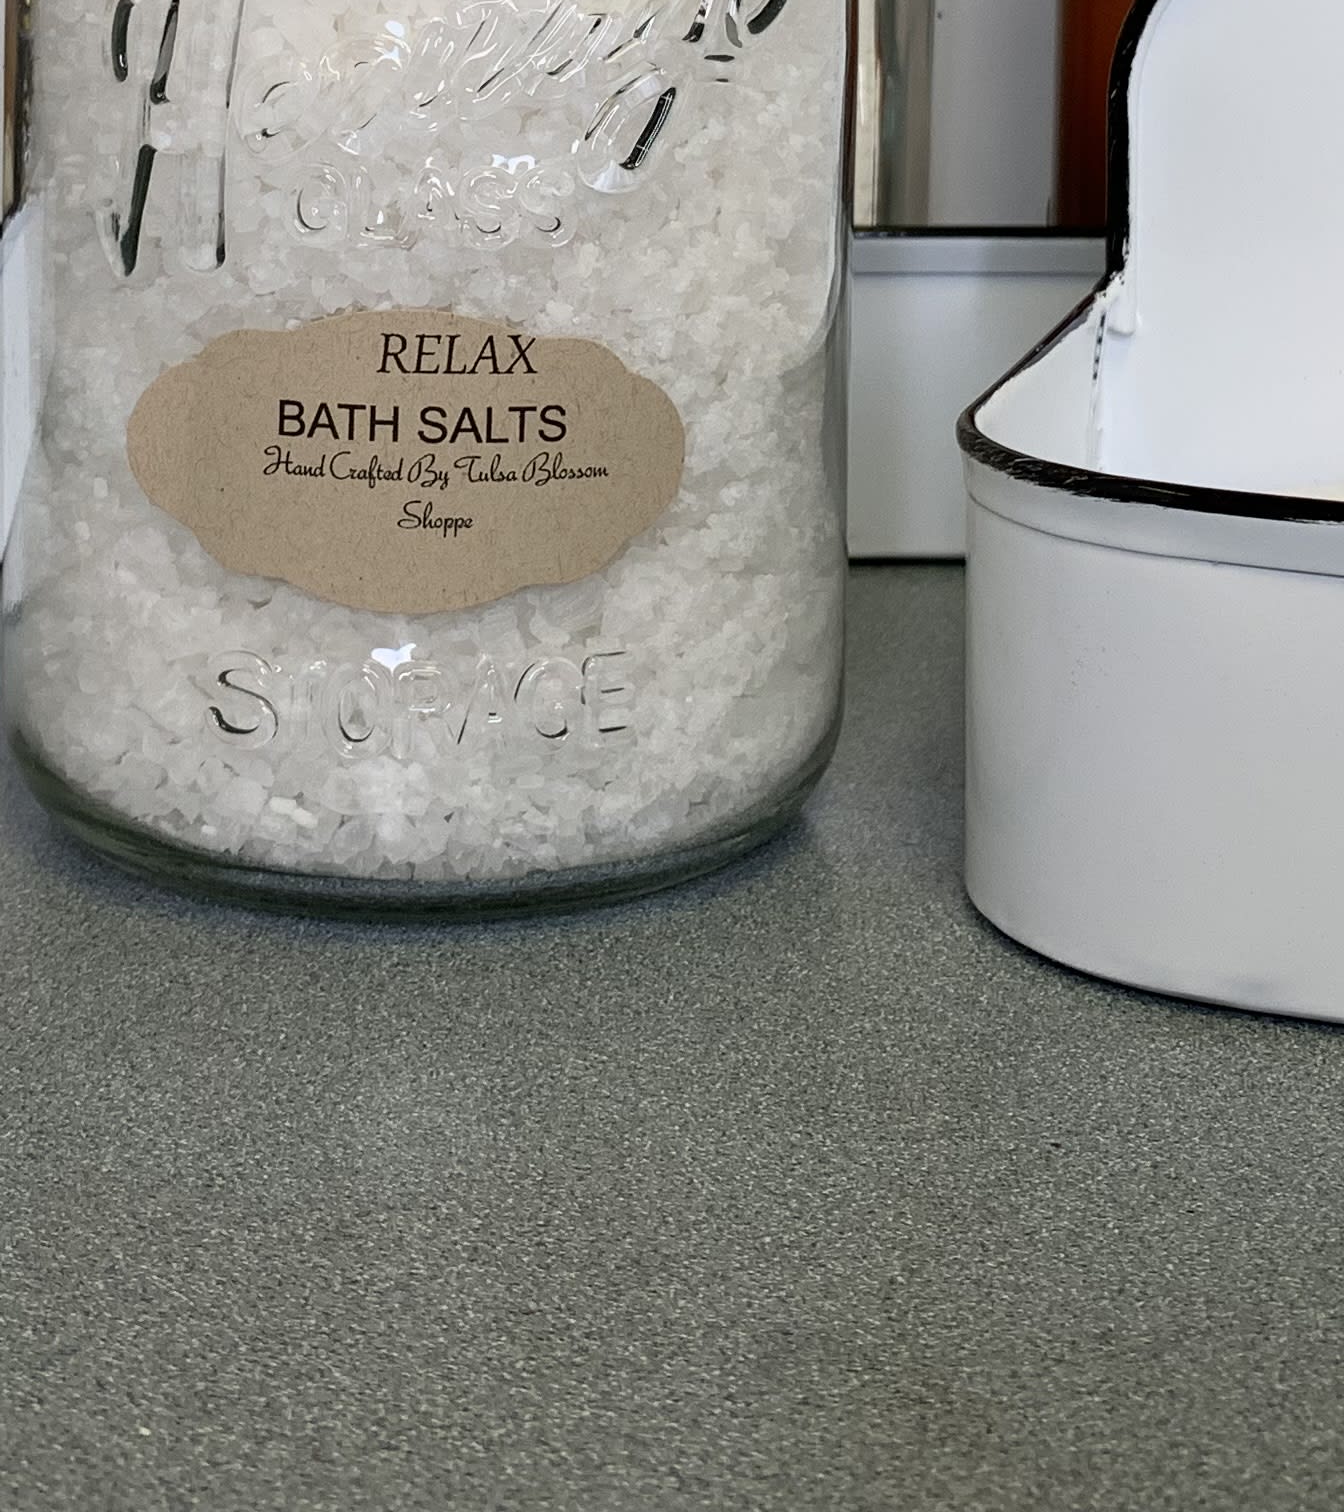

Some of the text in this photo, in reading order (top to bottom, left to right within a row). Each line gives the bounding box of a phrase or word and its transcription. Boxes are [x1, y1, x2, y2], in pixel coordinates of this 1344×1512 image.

[375, 331, 539, 376] RELAX
[277, 398, 568, 445] BATH SALTS
[262, 444, 610, 489] Hand Crafted By Tulsa Blossom
[396, 499, 474, 539] Shoppe
